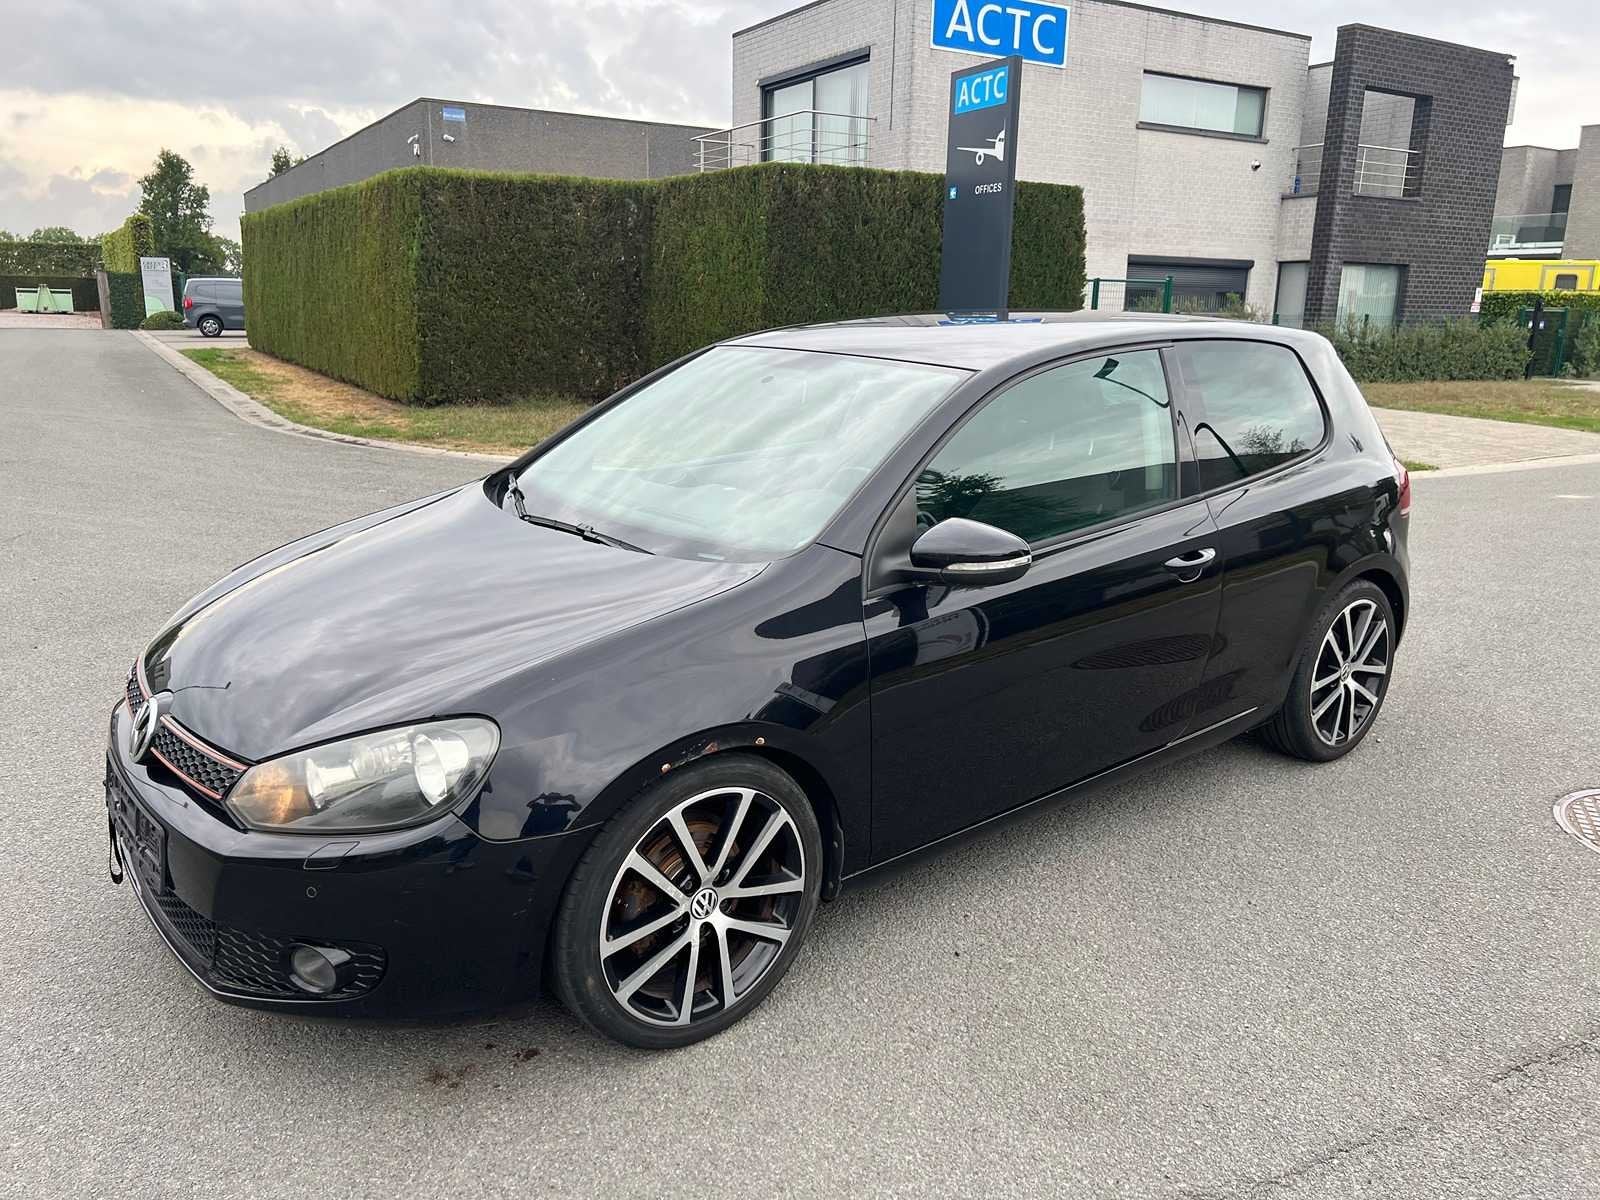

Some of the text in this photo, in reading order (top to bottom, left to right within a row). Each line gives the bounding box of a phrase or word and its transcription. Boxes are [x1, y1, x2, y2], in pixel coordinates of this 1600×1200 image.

[945, 0, 1057, 54] ACTC
[958, 71, 1005, 107] ACTC
[975, 182, 1002, 195] OFFICES
